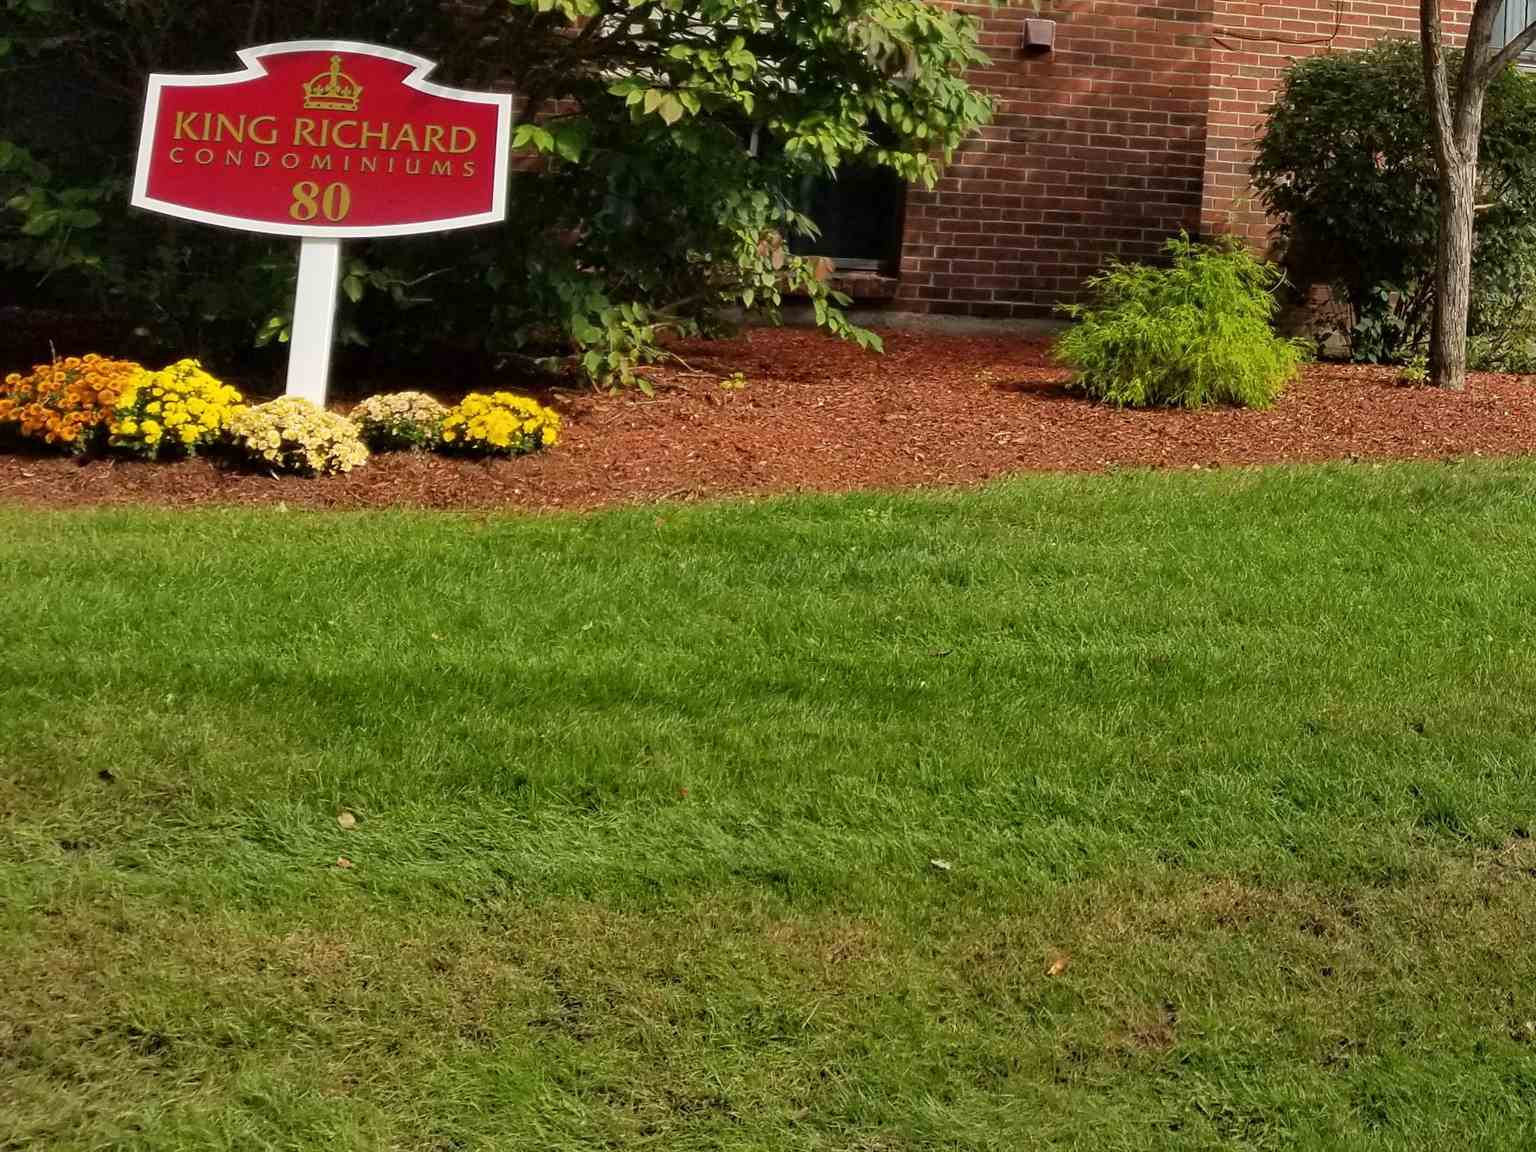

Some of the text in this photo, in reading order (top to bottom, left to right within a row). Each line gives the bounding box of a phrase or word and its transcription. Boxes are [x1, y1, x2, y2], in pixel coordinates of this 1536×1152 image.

[173, 111, 477, 154] KING RICHARD
[169, 147, 476, 177] CONDOMINIUMS
[288, 180, 351, 222] 80
